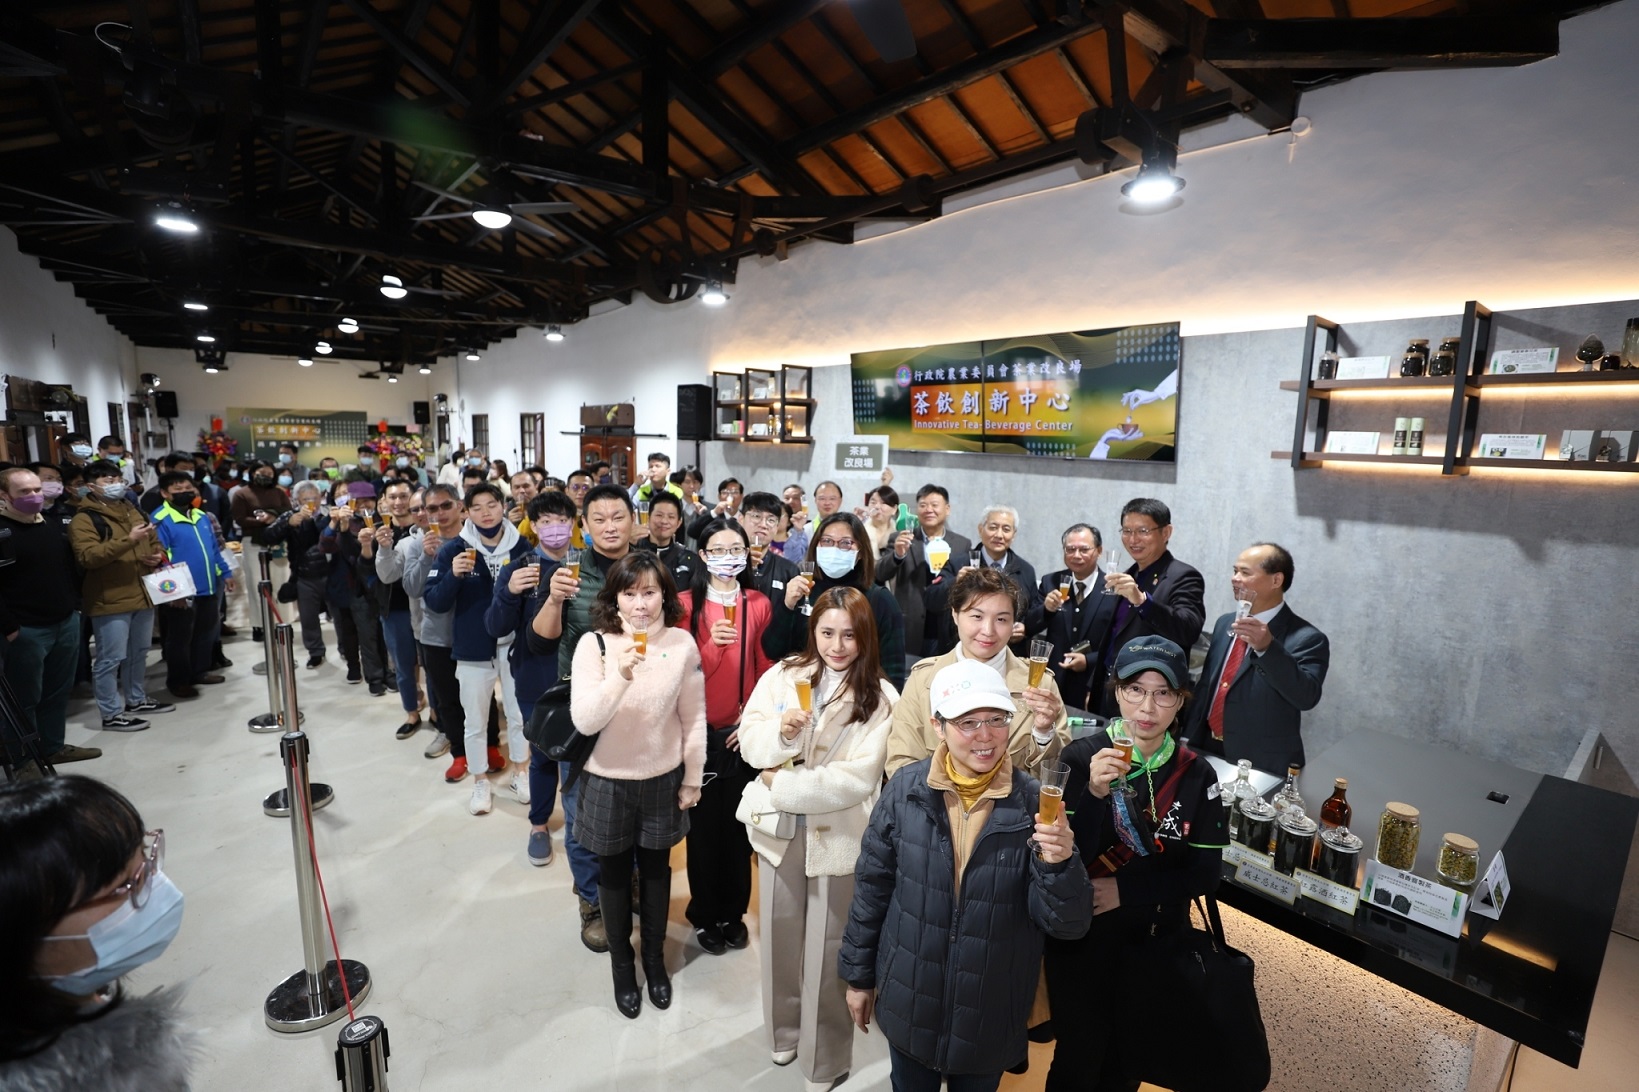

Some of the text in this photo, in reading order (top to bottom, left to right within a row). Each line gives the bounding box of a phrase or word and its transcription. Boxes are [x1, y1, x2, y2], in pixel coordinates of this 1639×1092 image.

[914, 359, 1082, 381] 行政院農業委員會茶業改良場
[914, 387, 1071, 416] 茶飲創新中心
[914, 419, 960, 430] Innovative
[1035, 420, 1074, 431] Center
[849, 446, 870, 456] 茶業
[844, 457, 874, 468] 改良場
[1243, 870, 1289, 896] 威士忌紅茶
